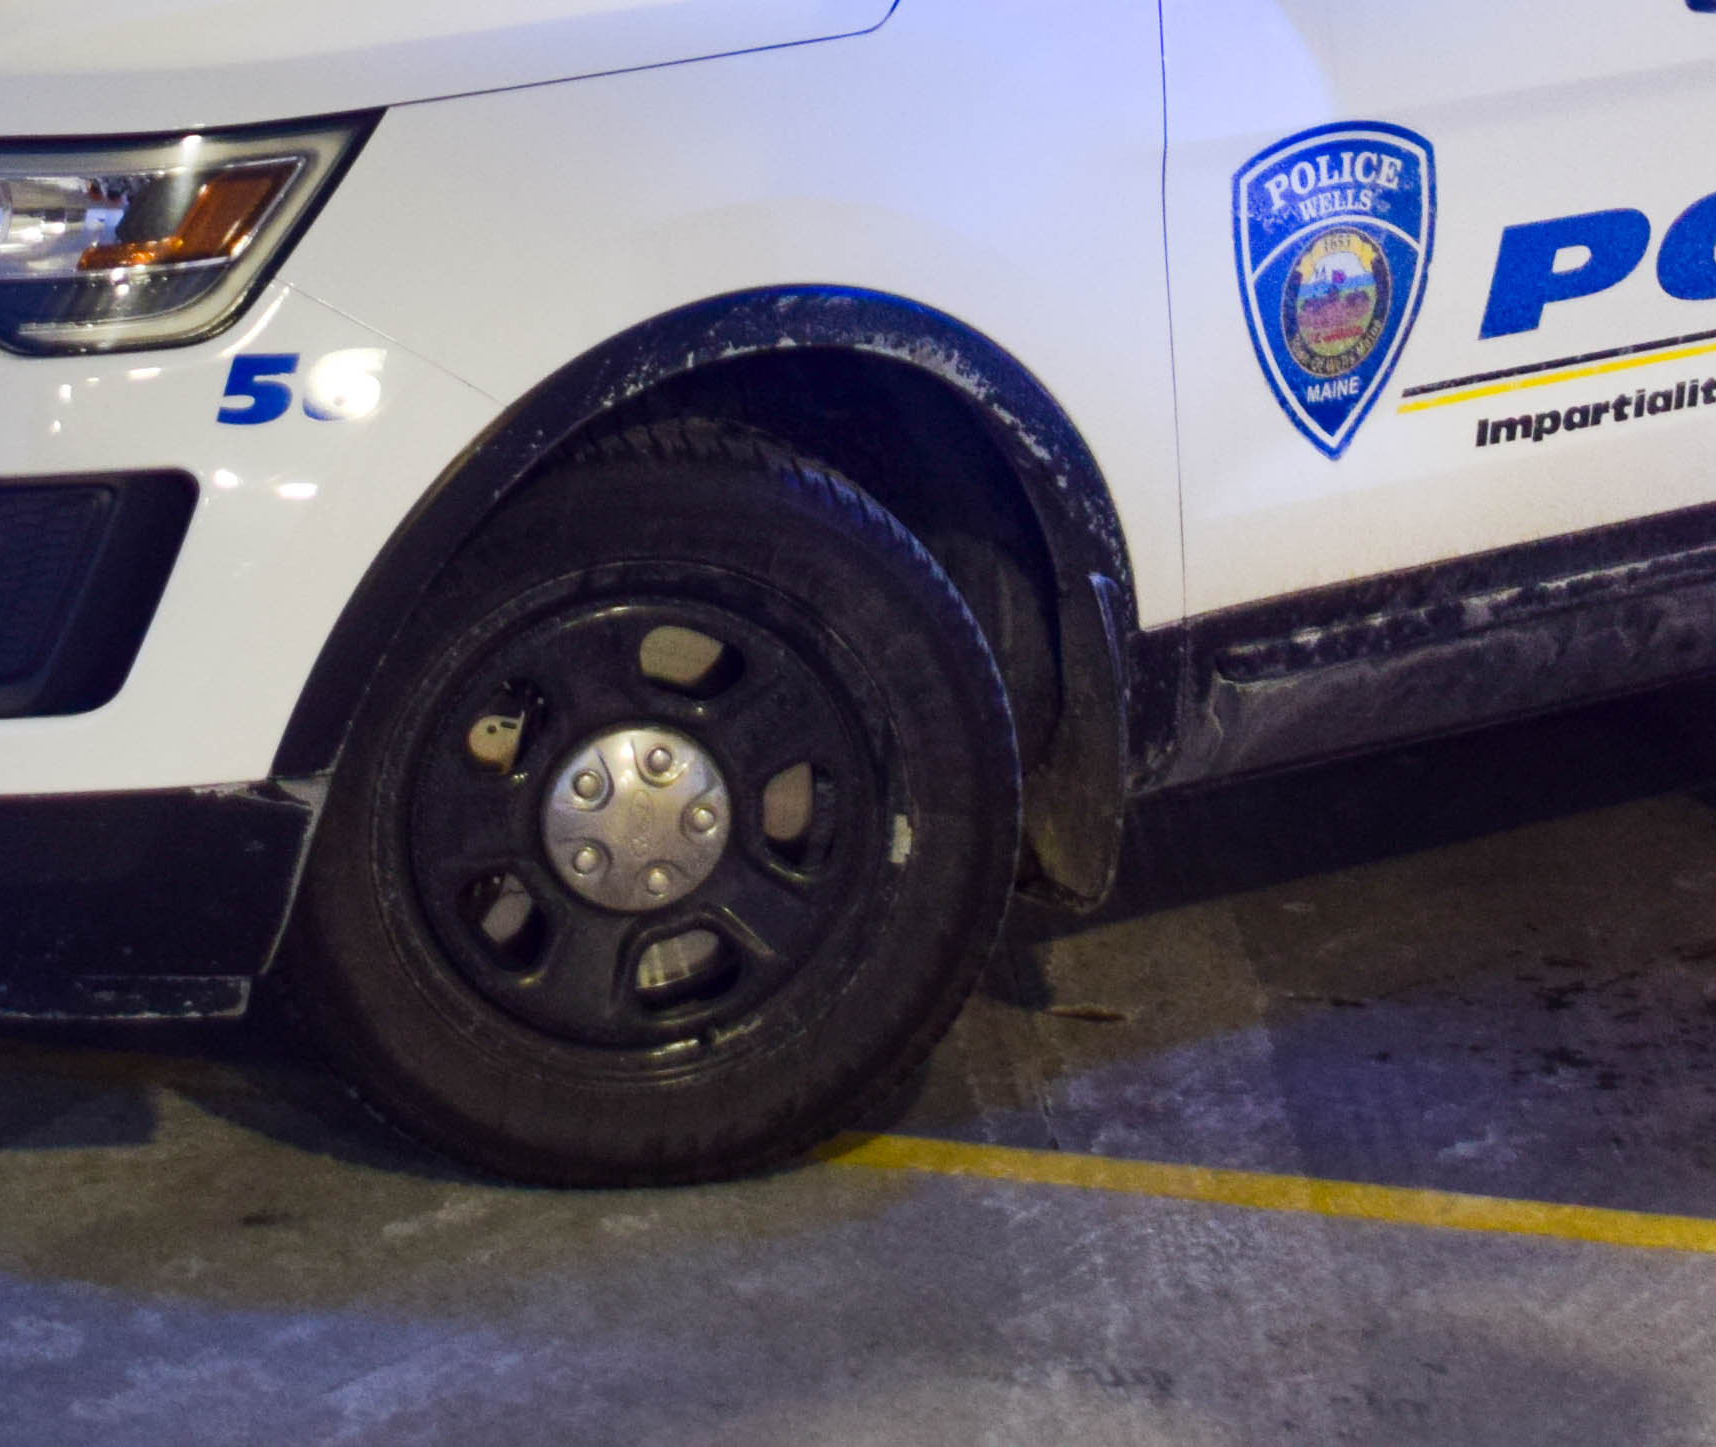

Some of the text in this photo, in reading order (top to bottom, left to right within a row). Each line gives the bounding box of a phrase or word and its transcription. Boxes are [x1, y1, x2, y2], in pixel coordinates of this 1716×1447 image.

[1264, 151, 1403, 210] POLICE
[1298, 189, 1373, 222] WELLS
[1306, 375, 1360, 403] MAINE
